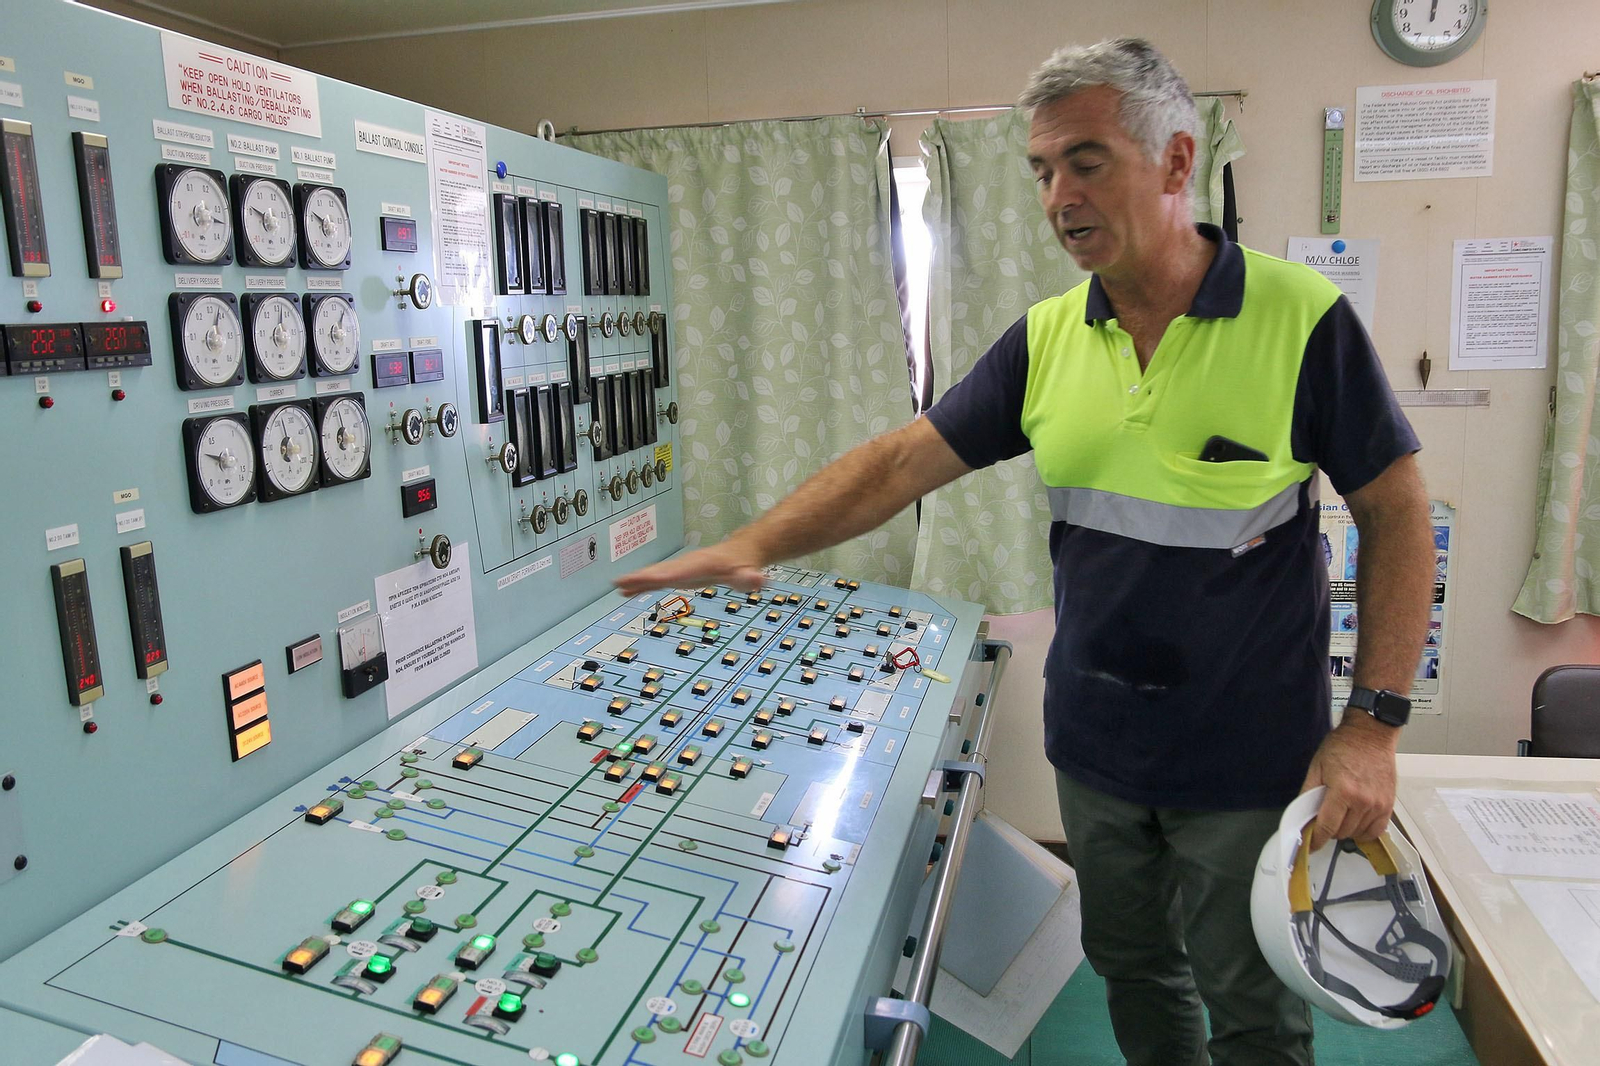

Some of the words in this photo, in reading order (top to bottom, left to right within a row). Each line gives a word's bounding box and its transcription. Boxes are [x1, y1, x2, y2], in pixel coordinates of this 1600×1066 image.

[1400, 9, 1408, 18] 9
[1459, 4, 1467, 14] 3
[1403, 22, 1411, 33] 8
[1454, 20, 1461, 29] 4
[1414, 33, 1421, 42] 7
[1428, 36, 1435, 46] 6
[1443, 31, 1451, 40] 5
[226, 57, 268, 80] CAUTION
[209, 73, 228, 87] OPEN
[232, 80, 251, 92] HOLD
[255, 85, 302, 105] VENTILATORS
[180, 80, 203, 94] WHEN
[206, 86, 311, 119] BALLASTING/DEBALLASTING
[182, 94, 192, 105] OF
[197, 97, 235, 115] NO.2,4,6
[239, 107, 262, 120] CARGO
[157, 126, 175, 136] BALLAST
[175, 130, 195, 140] STRIPPING
[195, 133, 211, 142] EDUCTOR
[230, 140, 241, 149] NO.2
[243, 142, 264, 153] BALLAST
[265, 146, 277, 154] PUMP
[359, 131, 380, 145] BALLAST
[382, 136, 403, 150] CONTROL
[404, 141, 424, 155] CONSOLE
[166, 149, 185, 158] SUCTION
[186, 152, 207, 161] PRESSURE
[294, 152, 303, 160] NO.1
[304, 153, 322, 163] BALLAST
[323, 157, 334, 165] PUMP
[238, 161, 255, 169] SUCTION
[256, 164, 274, 172] PRESSURE
[315, 172, 331, 180] PRESSURE
[1306, 255, 1327, 265] M/V
[1329, 256, 1359, 265] CHLOE
[178, 277, 199, 285] DELIVERY
[31, 329, 55, 354] 252
[270, 389, 284, 397] CURRENT
[193, 401, 211, 409] DRIVING
[212, 399, 230, 407] PRESSURE
[395, 656, 406, 665] PRIOR
[407, 646, 424, 659] COMMENCE
[425, 637, 442, 650] BALLASTING
[446, 630, 456, 639] CARGO
[404, 659, 416, 669] ENSURE
[422, 648, 437, 659] YOURSELF
[450, 633, 465, 644] MANHOLES
[440, 649, 451, 658] CLOSED
